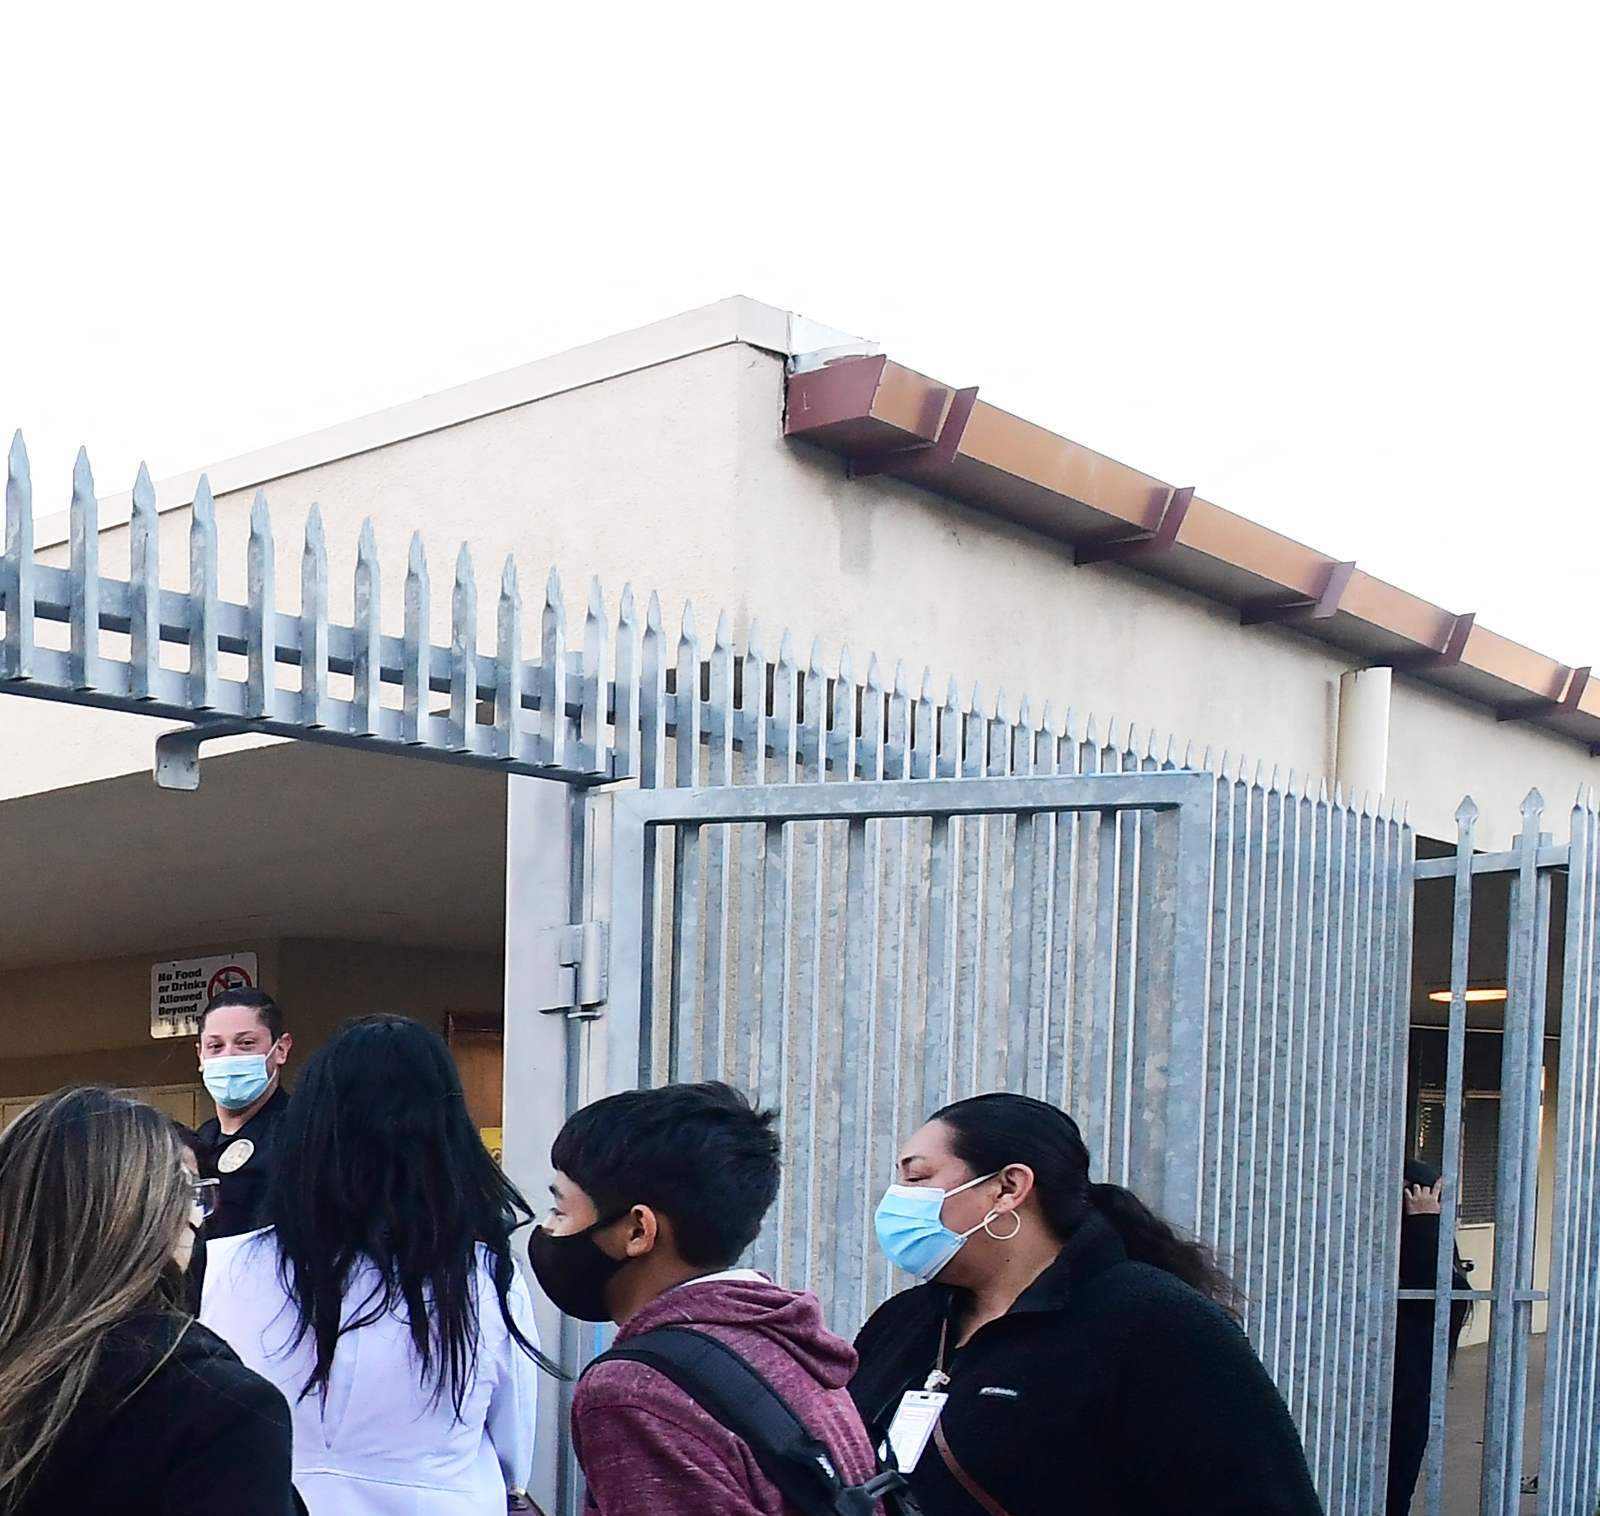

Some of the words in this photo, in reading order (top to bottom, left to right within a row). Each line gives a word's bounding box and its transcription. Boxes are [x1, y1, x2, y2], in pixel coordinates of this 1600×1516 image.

[158, 972, 172, 981] No
[175, 967, 202, 980] Food
[158, 985, 170, 993] or
[171, 980, 207, 992] Drinks
[159, 991, 203, 1004] Allowed
[158, 1003, 198, 1016] Beyond
